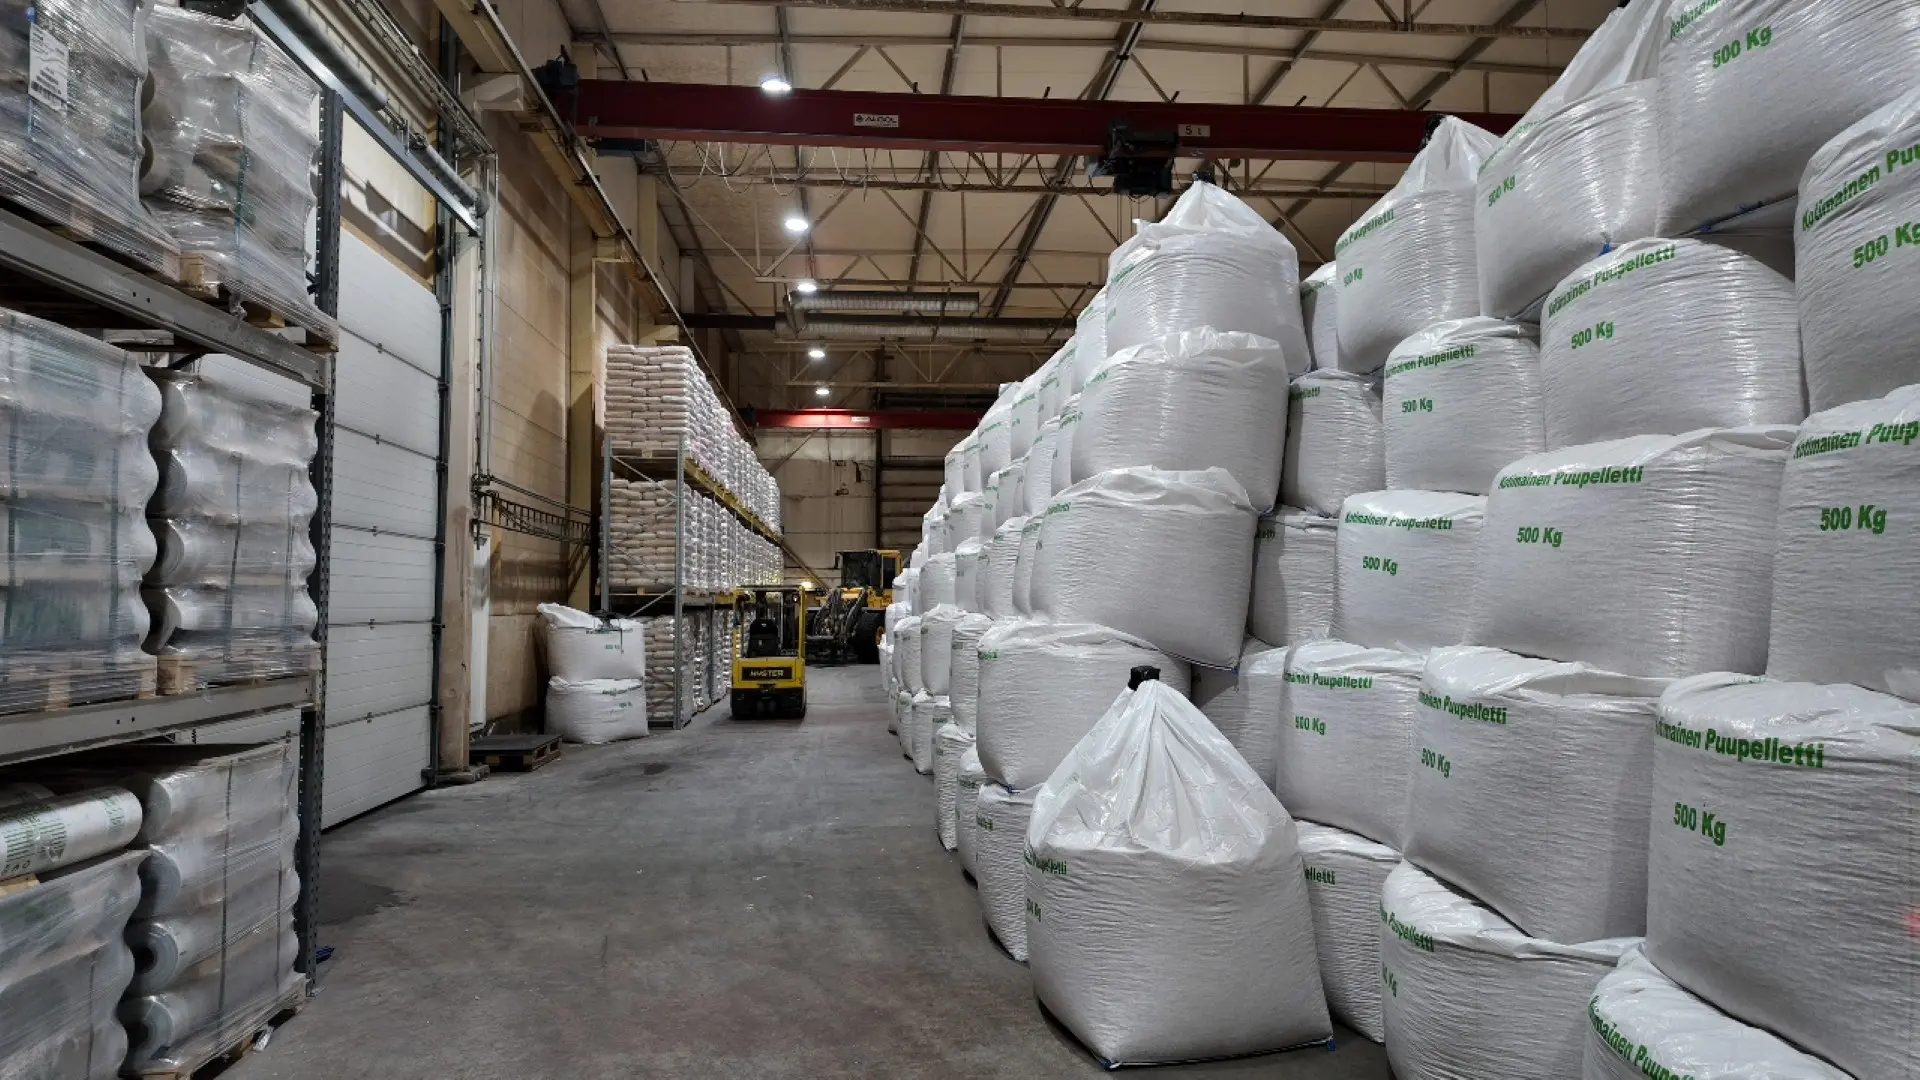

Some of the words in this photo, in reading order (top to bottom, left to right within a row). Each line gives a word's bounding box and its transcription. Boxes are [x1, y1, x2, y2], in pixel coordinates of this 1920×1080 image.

[1713, 40, 1741, 69] 500
[1746, 26, 1772, 51] Kg
[1185, 125, 1193, 136] 5
[1853, 234, 1889, 269] 500
[1571, 327, 1592, 350] 500
[1596, 320, 1614, 339] Kg
[1419, 397, 1433, 412] Kg
[1552, 465, 1645, 489] Puupelletti
[1820, 506, 1852, 532] 500
[1857, 504, 1887, 535] Kg
[1516, 526, 1540, 544] 500
[1542, 526, 1564, 548] Kg
[1362, 555, 1381, 571] 500
[1382, 558, 1399, 577] Kg
[1443, 695, 1508, 725] Puupelletti
[1312, 717, 1326, 736] Kg
[1704, 727, 1825, 769] Puupelletti
[1437, 753, 1451, 779] Kg
[1673, 801, 1698, 832] 500
[1702, 811, 1727, 847] Kg
